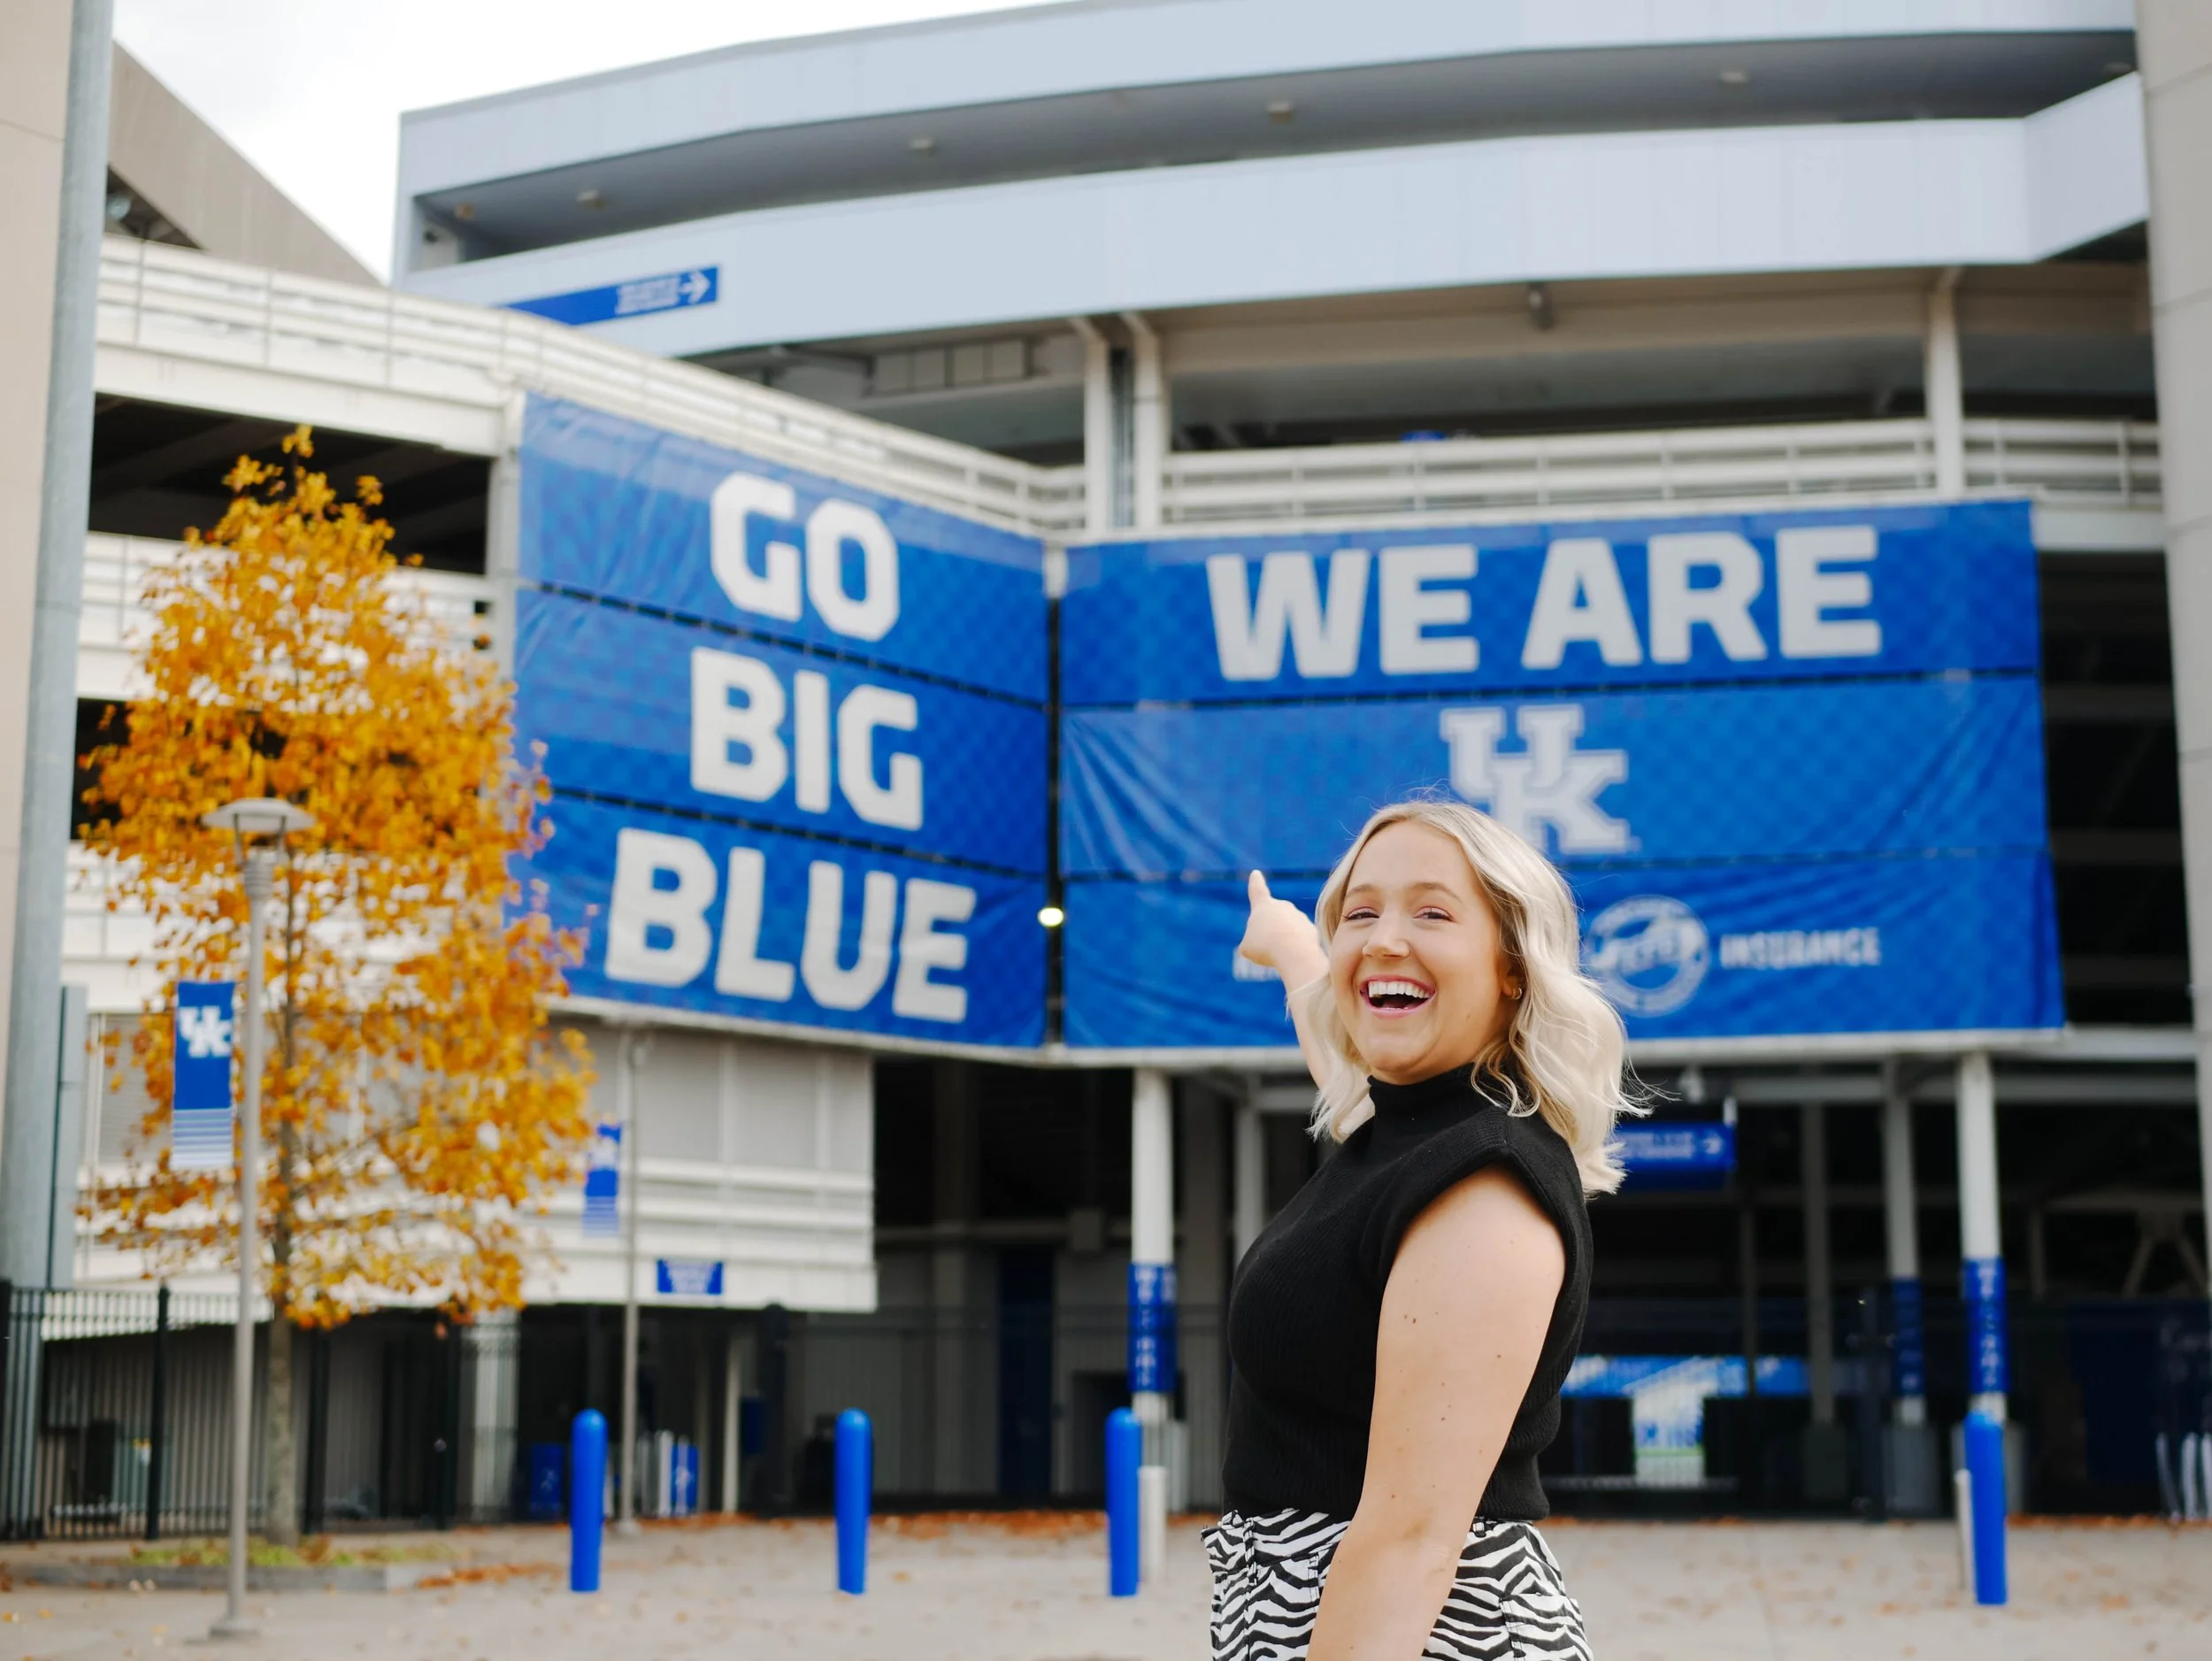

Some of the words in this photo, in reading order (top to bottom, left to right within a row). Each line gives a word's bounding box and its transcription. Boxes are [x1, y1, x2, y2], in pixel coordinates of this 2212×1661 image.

[711, 473, 899, 642] GO
[1207, 544, 1479, 681] WE
[1522, 527, 1882, 670] ARE
[691, 648, 923, 830] BIG
[1440, 704, 1629, 855] UK
[605, 827, 976, 1023] BLUE
[1720, 928, 1880, 970] INSURANCE
[180, 1006, 232, 1057] UK
